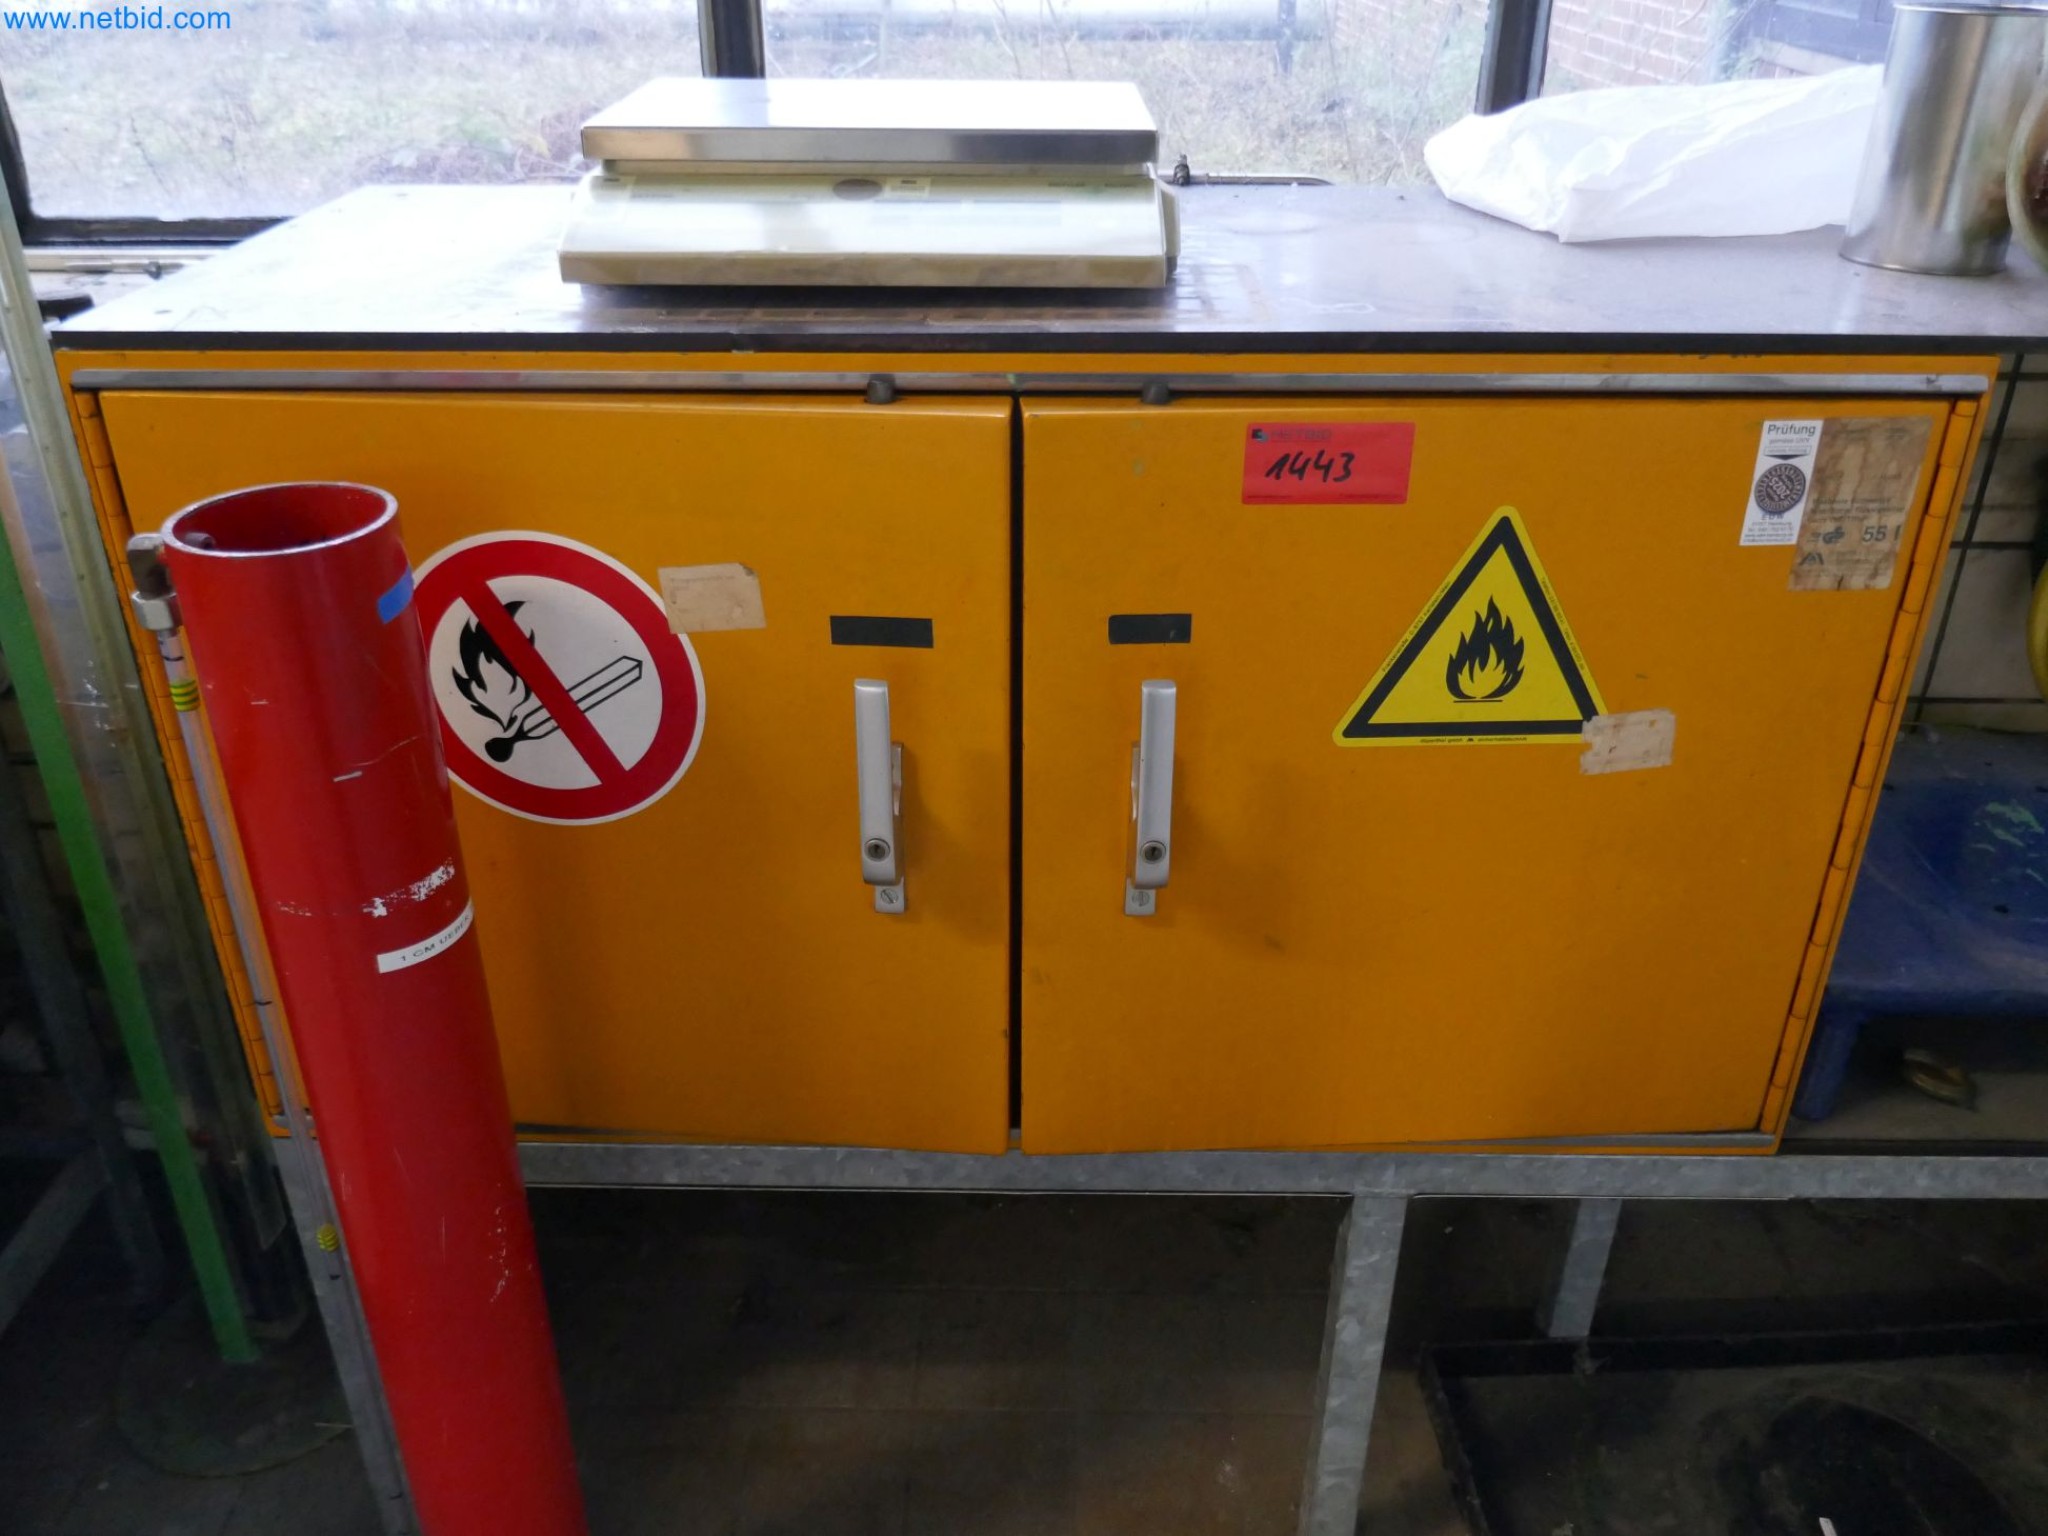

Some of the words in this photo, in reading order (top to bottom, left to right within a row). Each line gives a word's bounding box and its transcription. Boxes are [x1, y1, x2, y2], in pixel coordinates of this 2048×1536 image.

[1767, 423, 1816, 437] Prüfung
[1264, 449, 1356, 483] 1443
[1768, 476, 1791, 499] 2025
[1862, 525, 1886, 542] 55
[413, 944, 437, 958] CM
